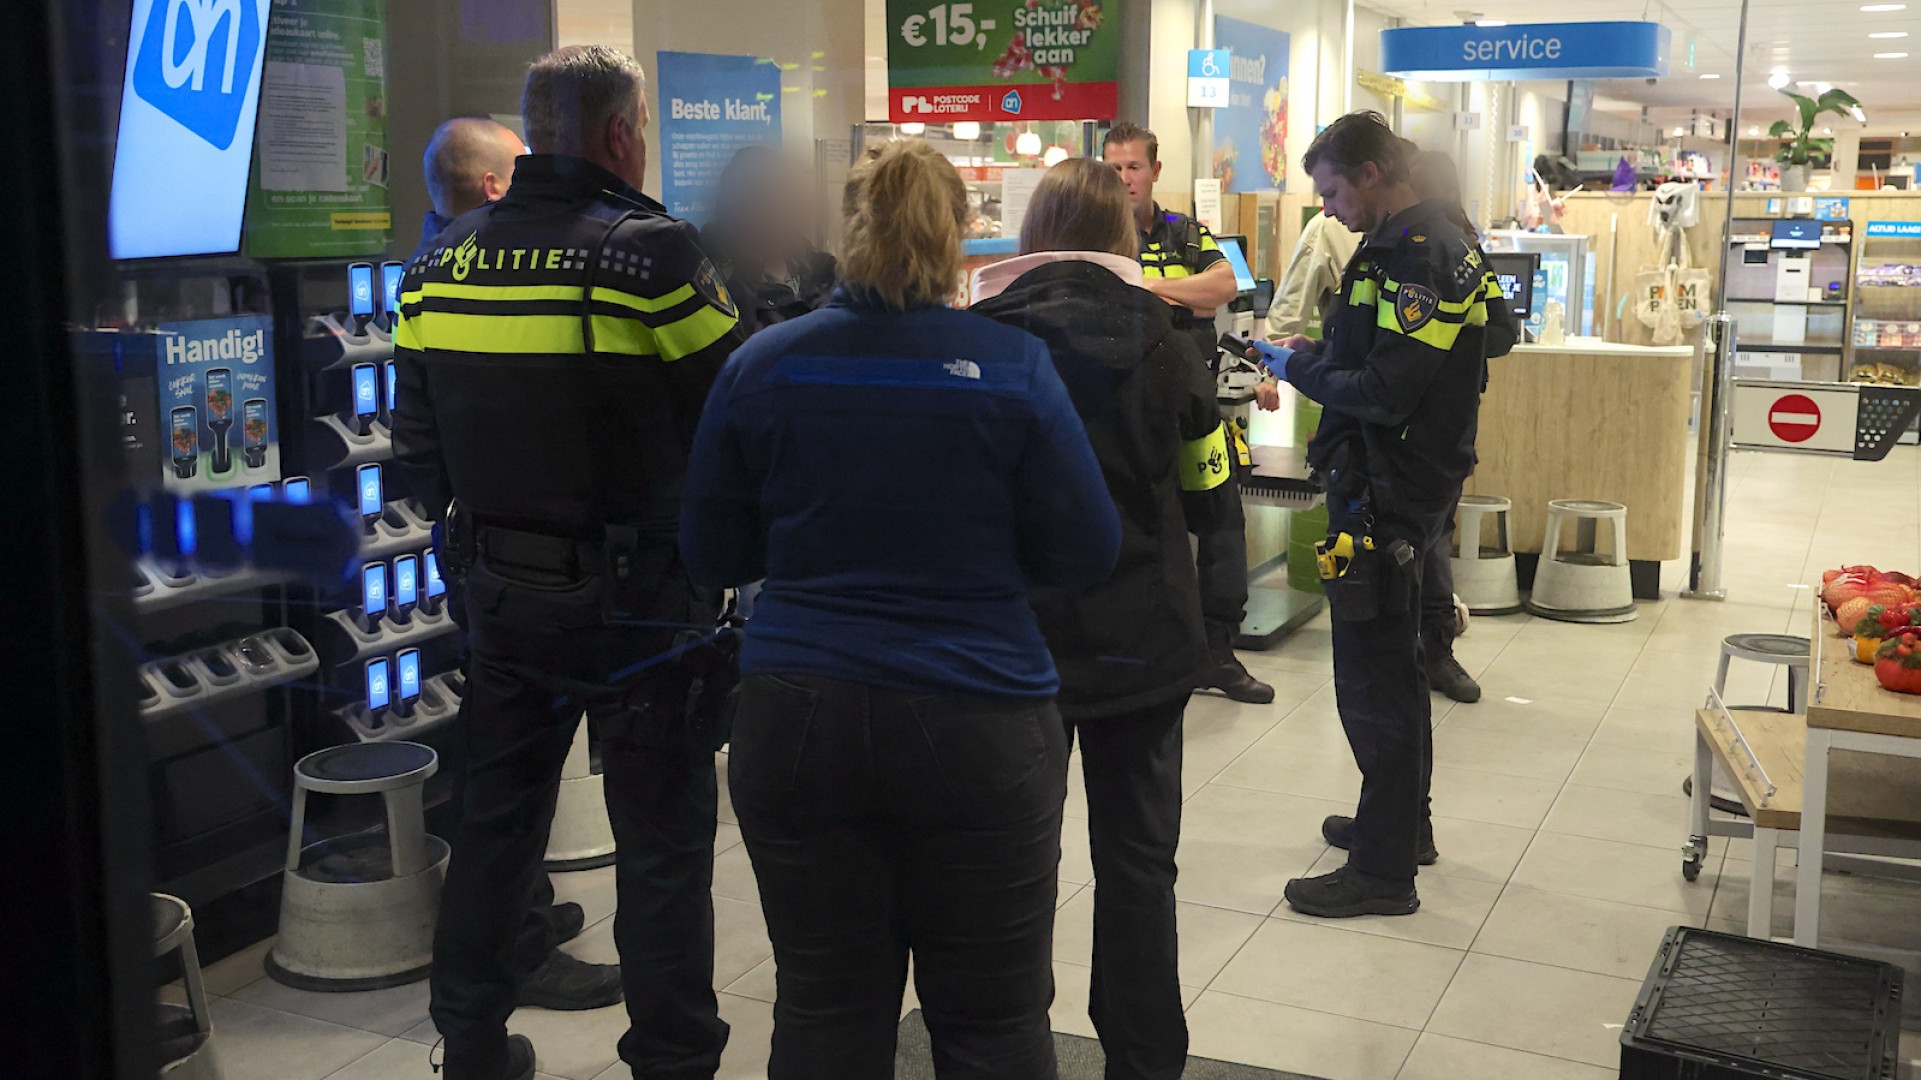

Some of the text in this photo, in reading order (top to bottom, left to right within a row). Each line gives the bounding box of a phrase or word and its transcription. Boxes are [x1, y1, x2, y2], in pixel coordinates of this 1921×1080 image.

[1014, 5, 1077, 29] Schuif
[1026, 26, 1090, 47] lekker
[1034, 48, 1074, 64] aan
[1463, 34, 1562, 61] service
[933, 95, 980, 103] POSTCODE
[933, 104, 968, 113] LOTERIJ
[671, 98, 771, 125] Beste klant,
[1897, 226, 1921, 234] LAAG
[166, 329, 264, 364] Handig!
